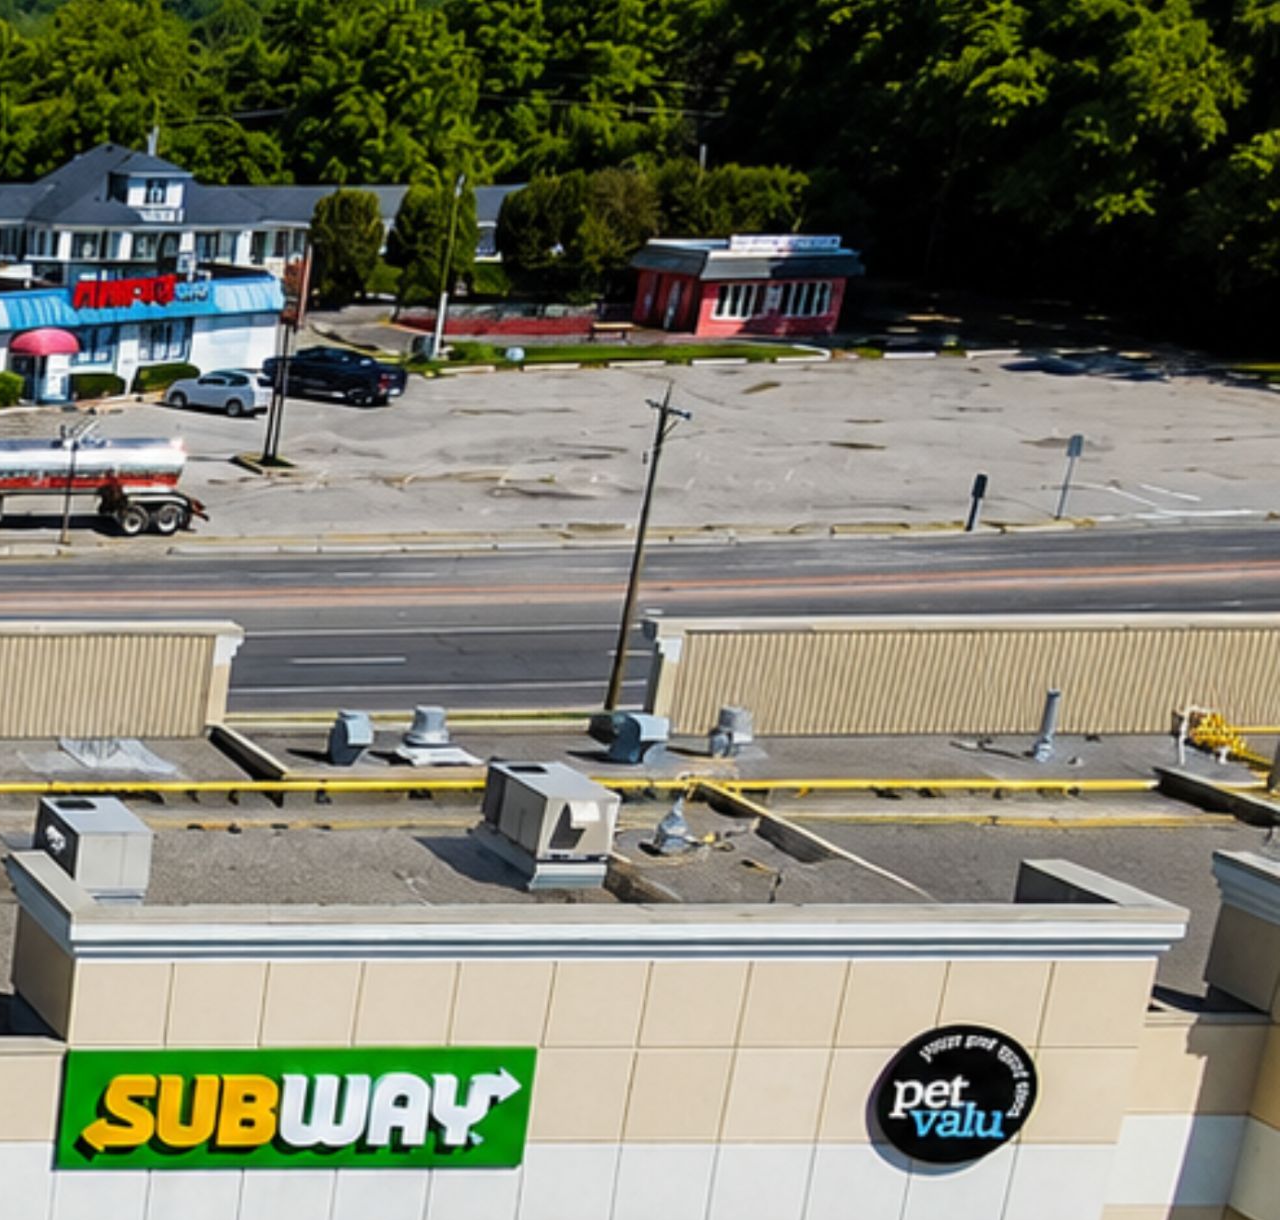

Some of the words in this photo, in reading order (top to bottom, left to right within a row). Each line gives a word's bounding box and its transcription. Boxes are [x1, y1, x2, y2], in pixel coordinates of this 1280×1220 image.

[81, 1066, 522, 1153] SUBWAY
[889, 1074, 970, 1118] pet
[910, 1101, 1004, 1138] valu
